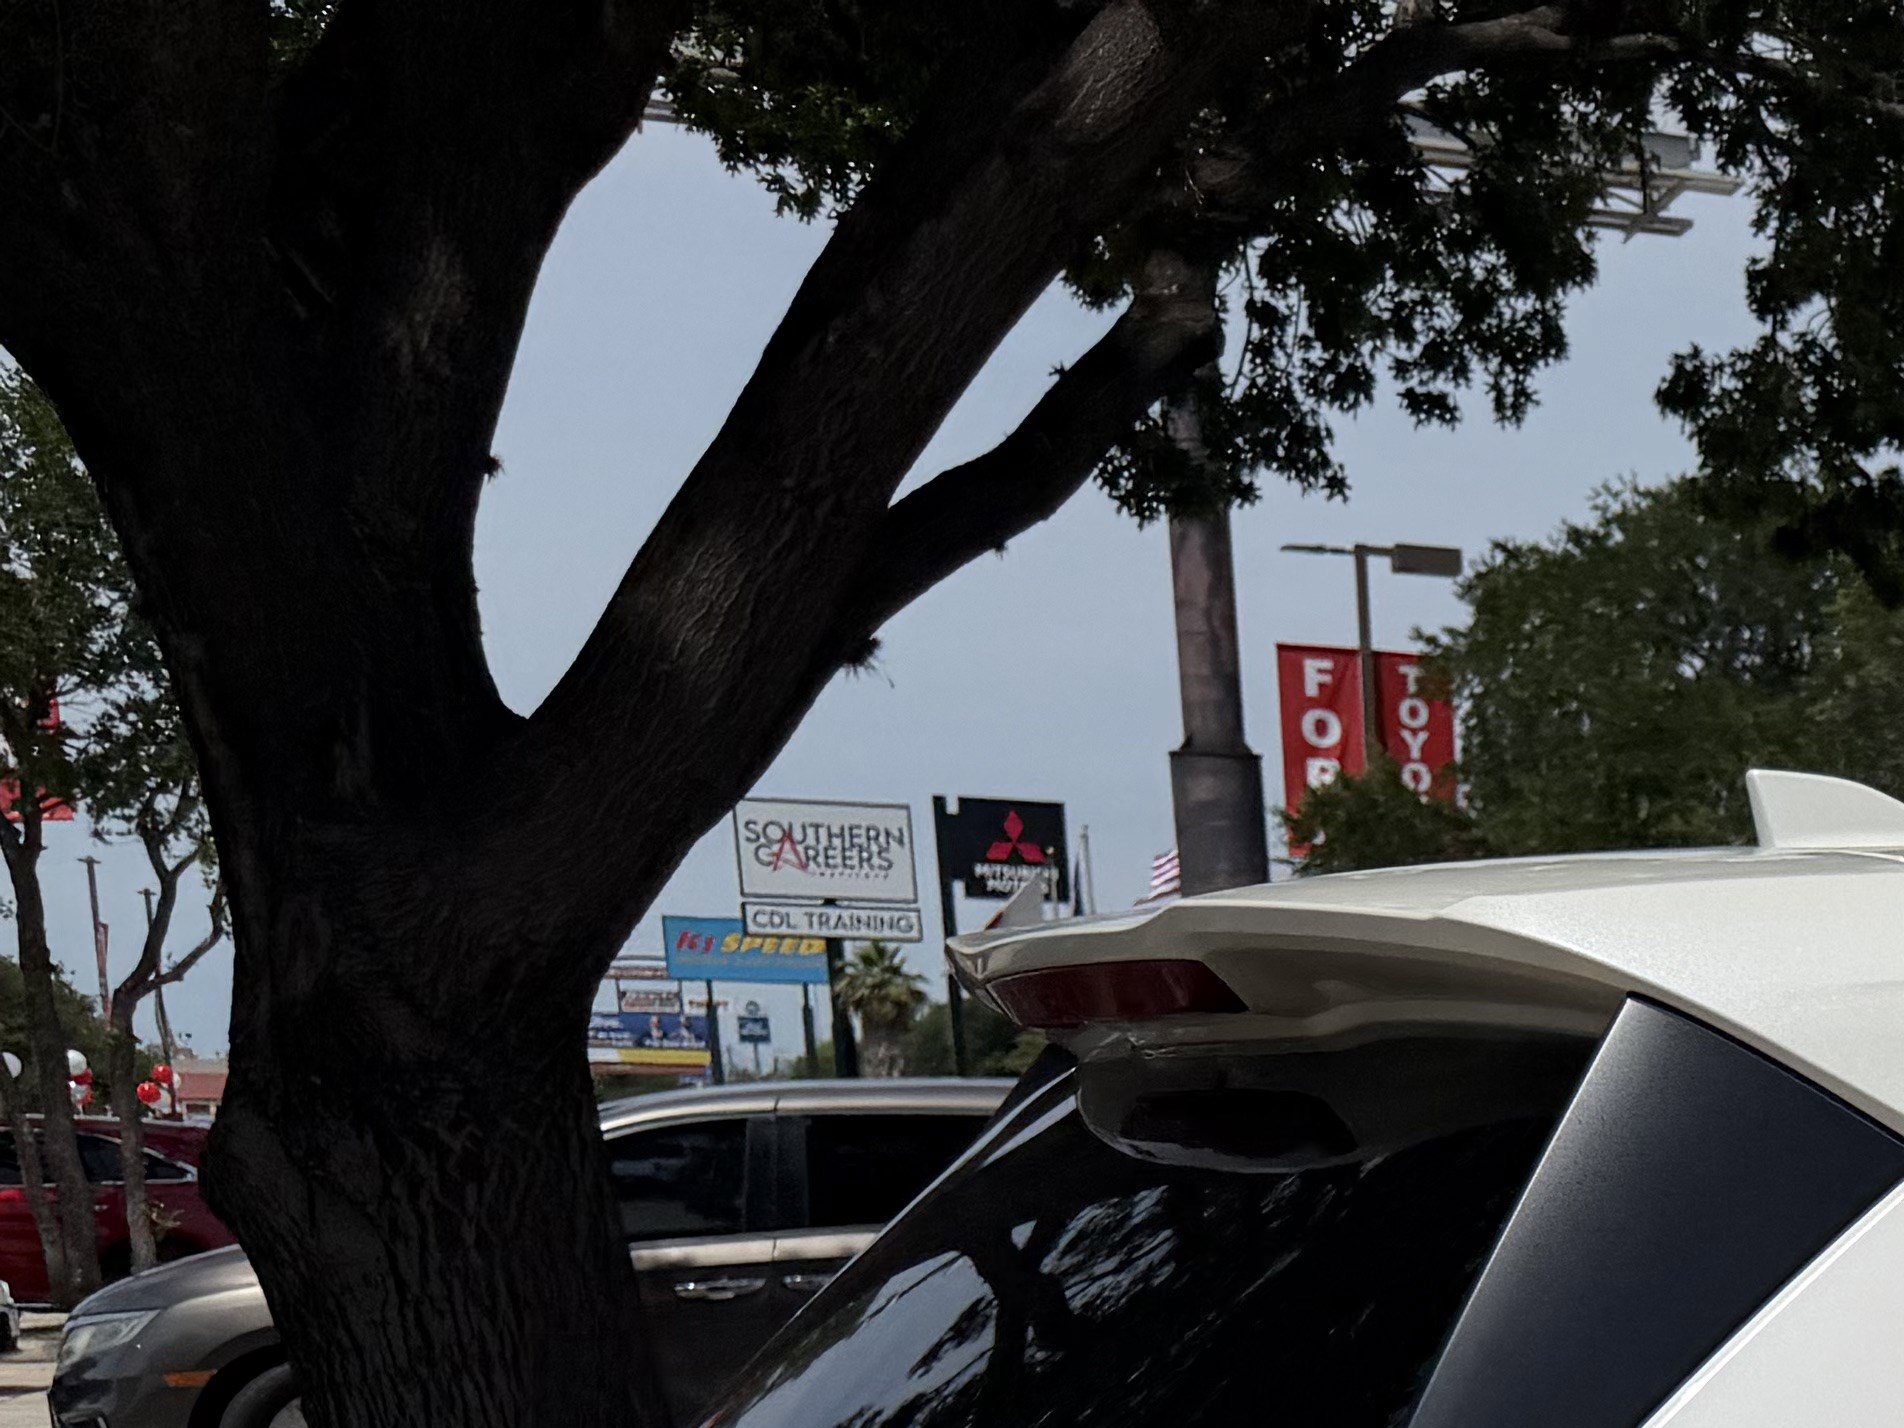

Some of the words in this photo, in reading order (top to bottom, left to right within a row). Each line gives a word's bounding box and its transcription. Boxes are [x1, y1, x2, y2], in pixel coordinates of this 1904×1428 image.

[1396, 664, 1433, 803] TOYO
[744, 819, 905, 848] SOUTHERN
[754, 833, 894, 872] CAREERS
[753, 909, 797, 930] CDL
[803, 911, 914, 934] TRAINING
[721, 932, 827, 956] SPEED
